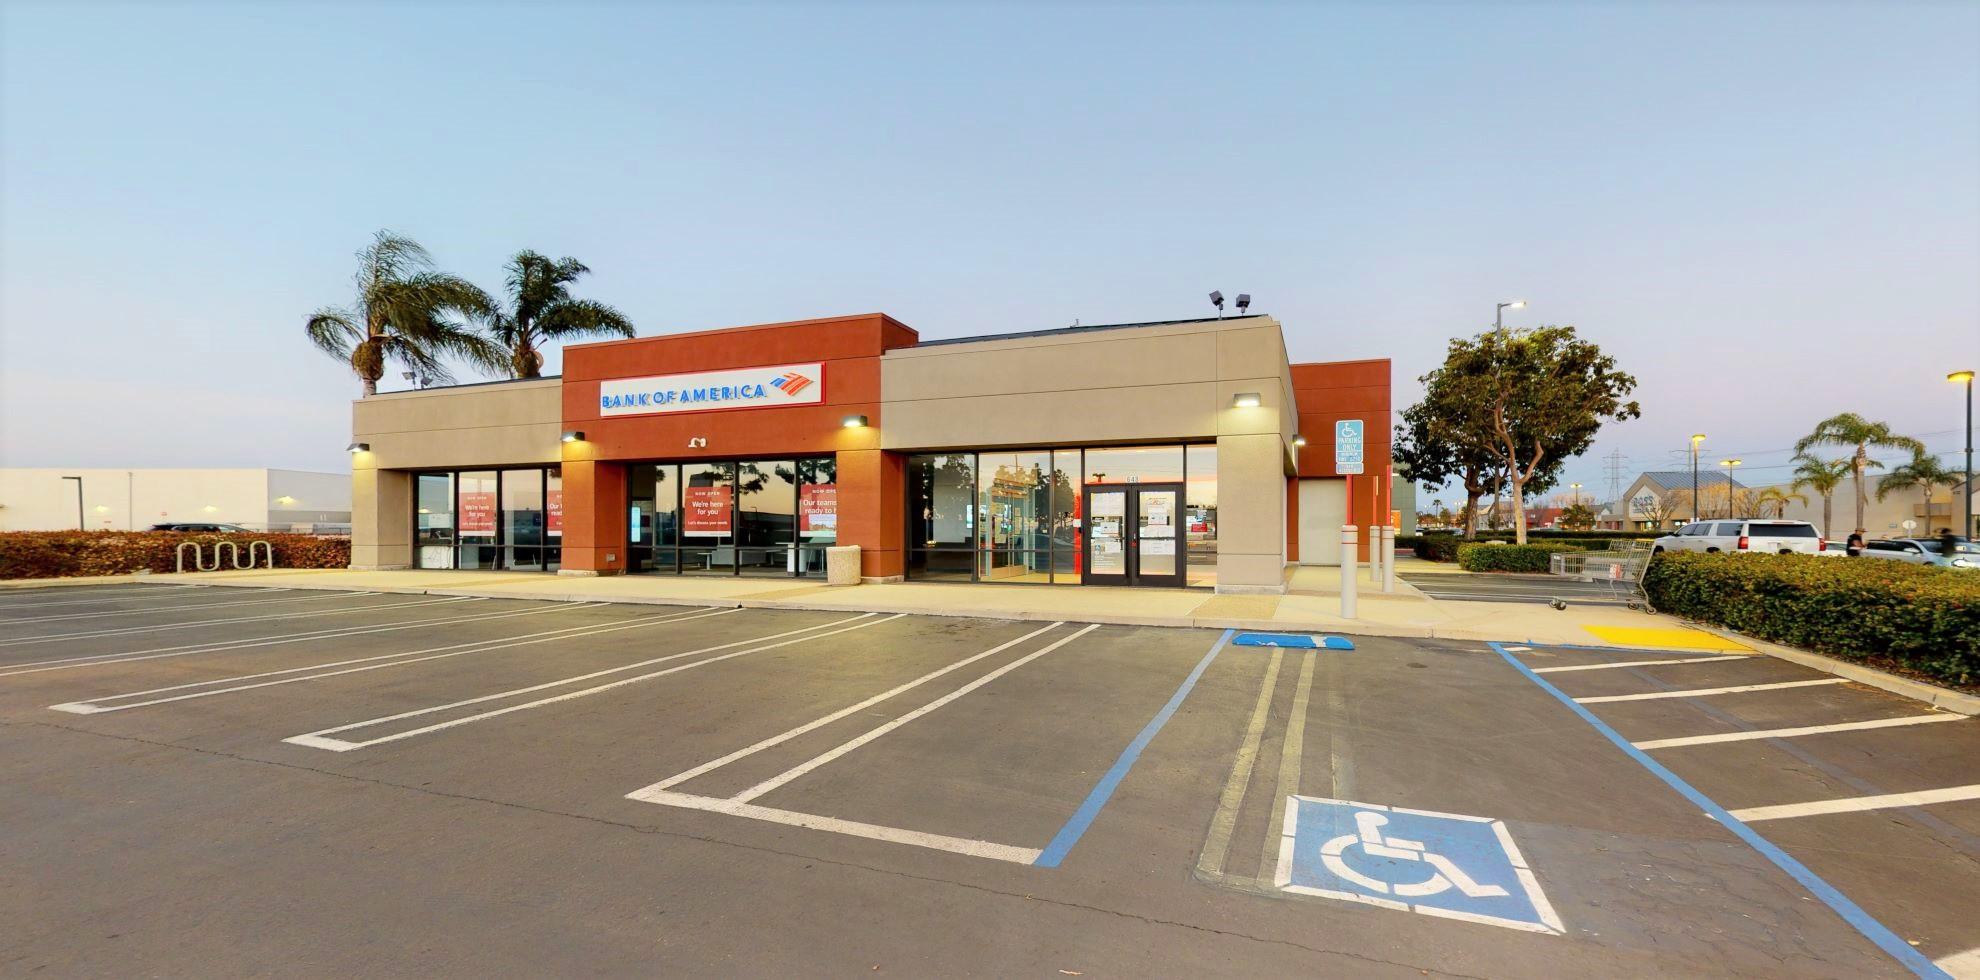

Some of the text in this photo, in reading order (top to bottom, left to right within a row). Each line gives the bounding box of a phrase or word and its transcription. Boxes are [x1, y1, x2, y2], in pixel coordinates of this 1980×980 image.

[602, 384, 767, 408] BANK OF AMERICA
[1342, 443, 1357, 451] ONLY
[692, 500, 724, 508] We're here
[707, 509, 719, 517] you
